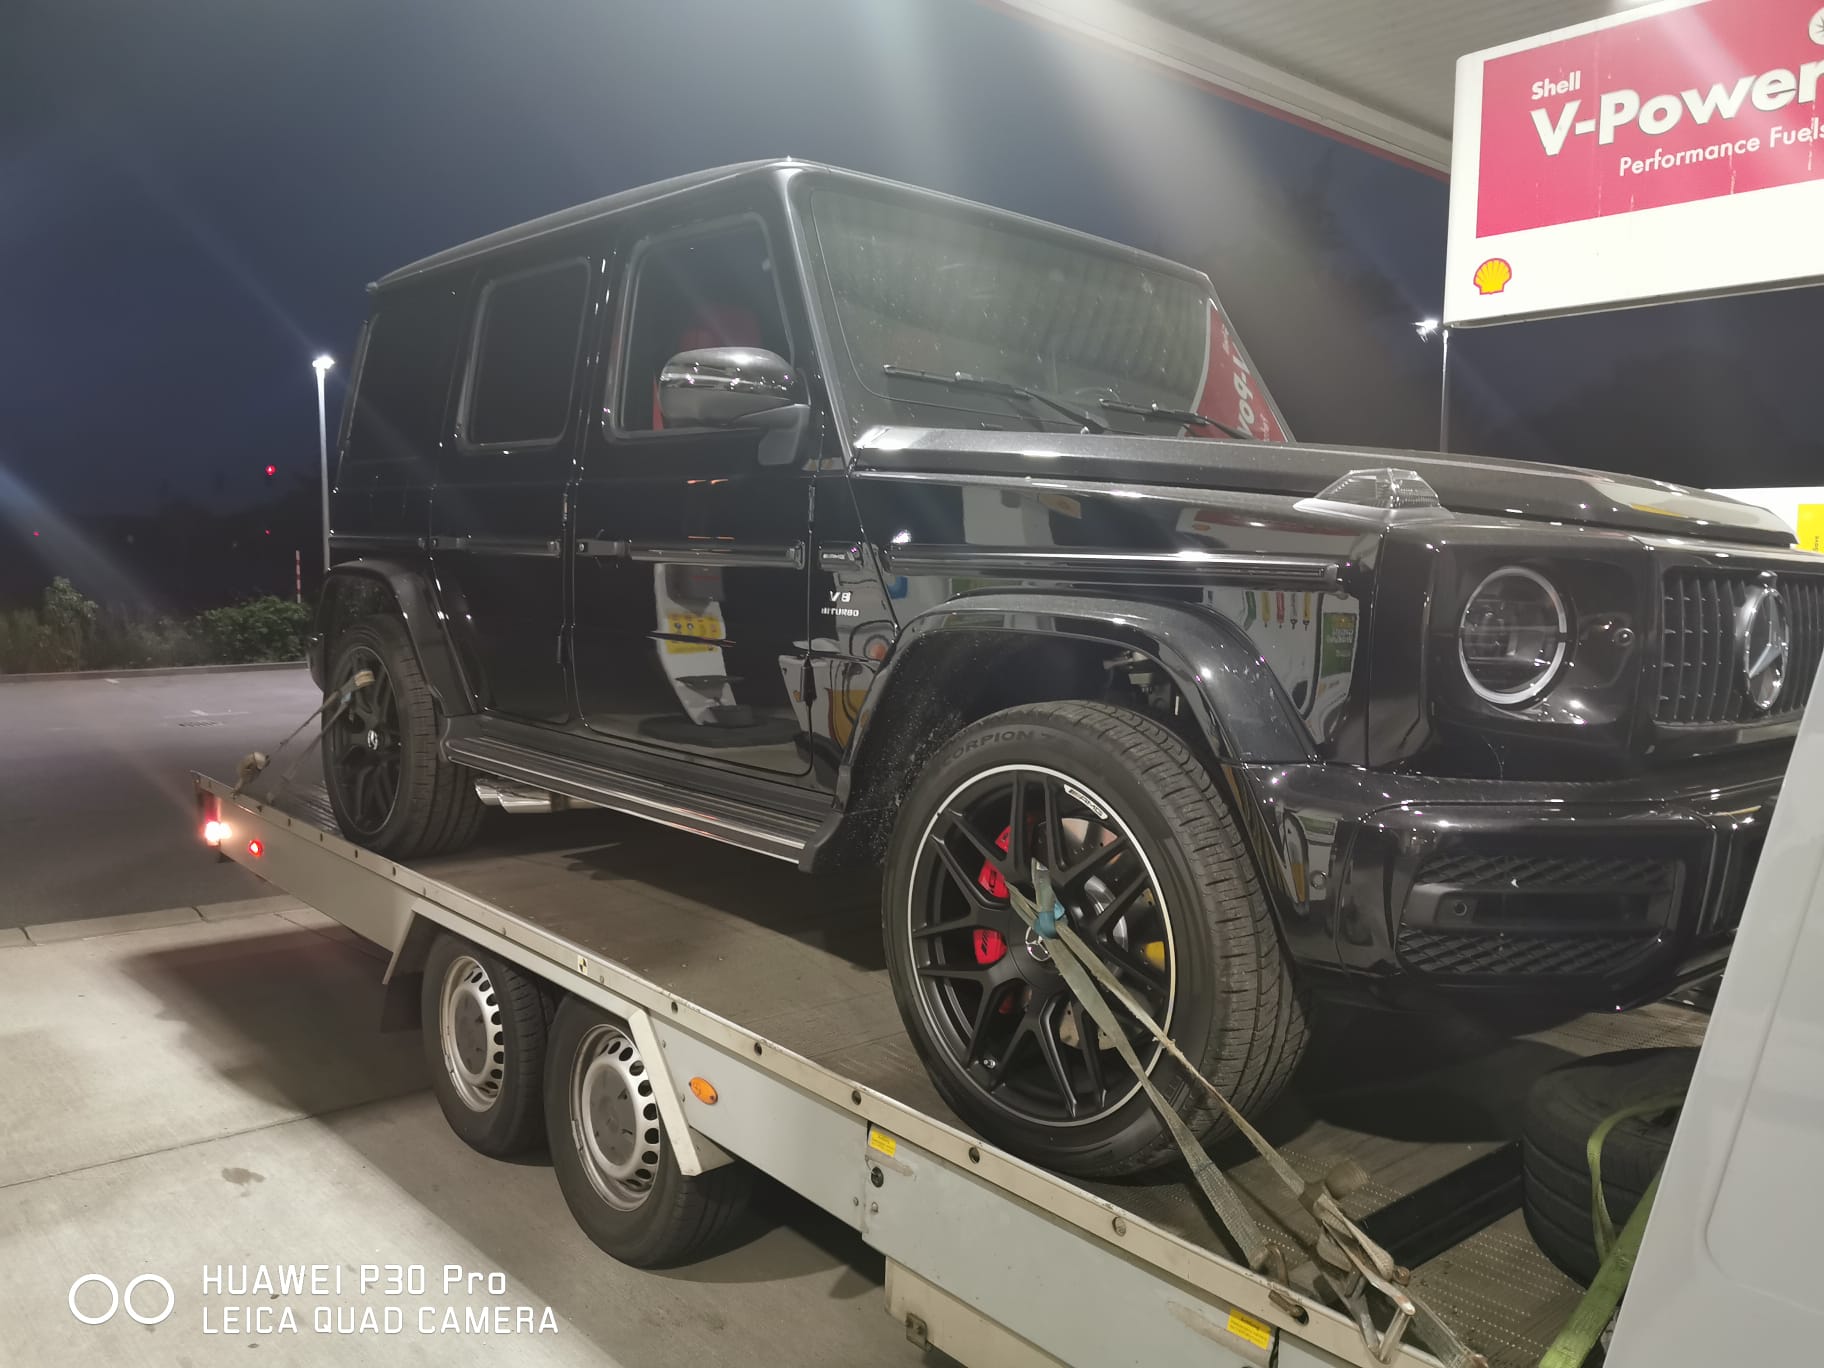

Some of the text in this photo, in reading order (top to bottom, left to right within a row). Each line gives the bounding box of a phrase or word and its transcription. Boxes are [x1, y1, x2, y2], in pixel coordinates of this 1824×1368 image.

[1531, 70, 1581, 100] Shell
[1530, 58, 1824, 157] V-Power
[1619, 137, 1760, 177] Performance
[829, 590, 851, 603] V8
